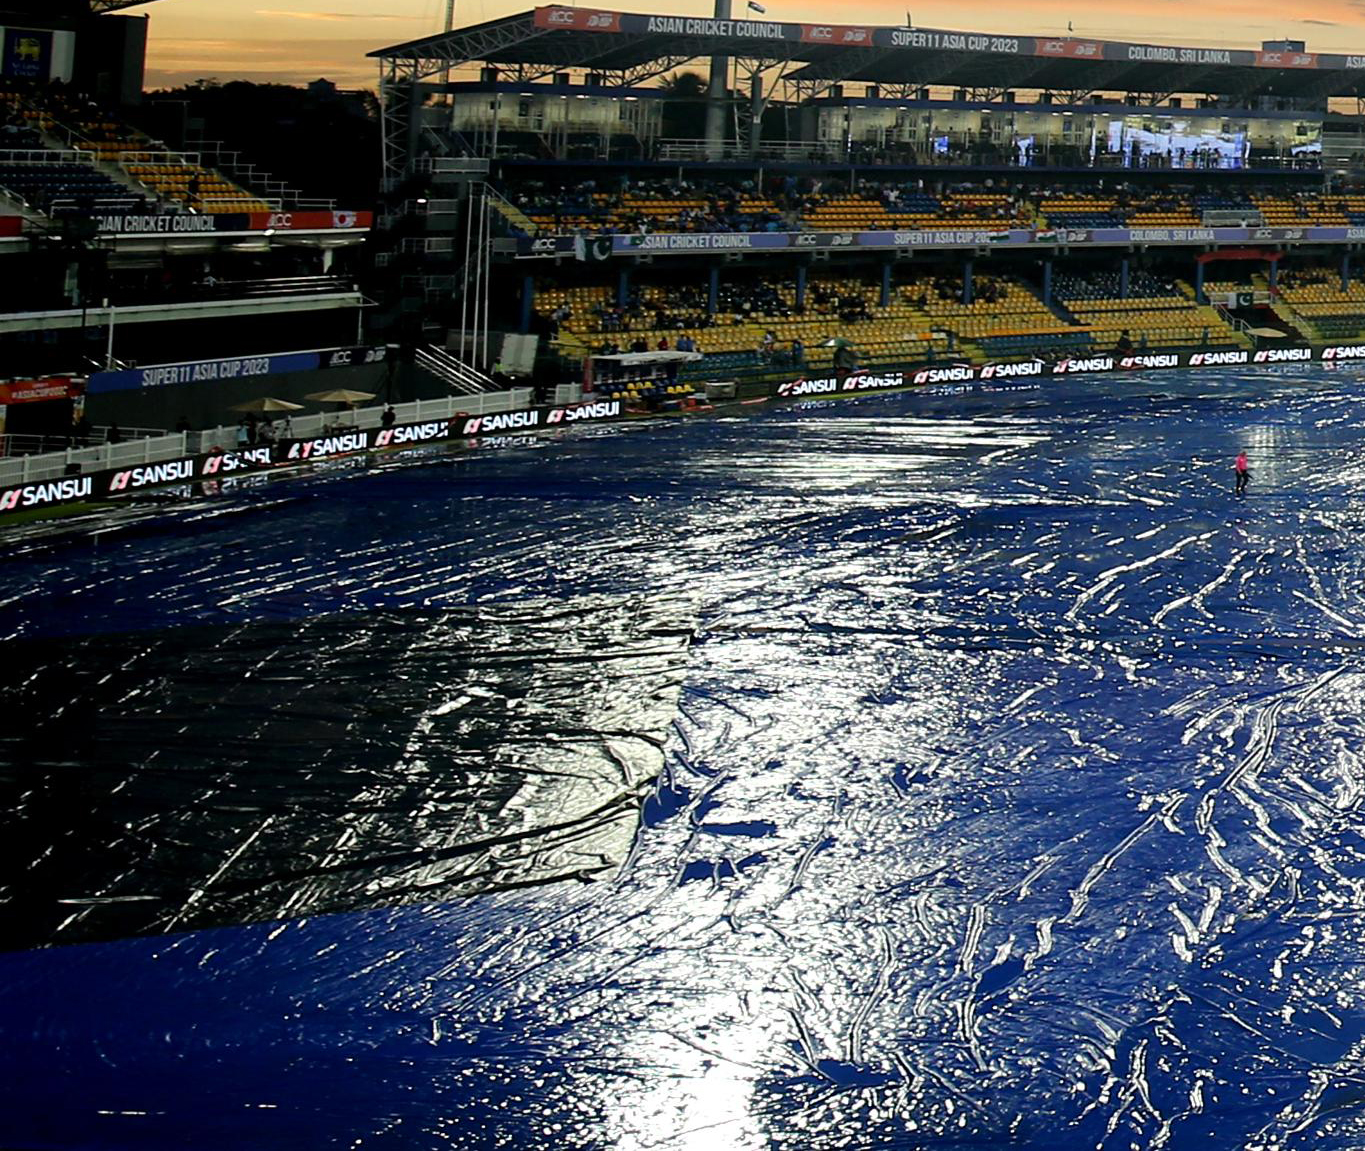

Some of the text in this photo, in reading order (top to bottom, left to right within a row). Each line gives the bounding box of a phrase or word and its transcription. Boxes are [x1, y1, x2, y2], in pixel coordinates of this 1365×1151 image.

[648, 16, 785, 39] ASIAN CRICKET COUNCIL
[942, 35, 966, 50] ASIA
[968, 37, 989, 51] CUP
[991, 37, 1018, 53] 2023
[1180, 49, 1197, 62] SRI
[1198, 50, 1231, 64] LANKA
[124, 215, 172, 231] CRICKET
[173, 215, 216, 230] COUNCIL
[670, 236, 711, 248] CRICKET
[713, 235, 752, 247] COUNCIL
[934, 232, 954, 244] ASIA
[955, 233, 974, 244] CUP
[1172, 230, 1186, 241] SRI
[1187, 229, 1214, 241] LANKA
[1204, 351, 1247, 365] SANSUI
[1267, 349, 1311, 362] SANSUI
[192, 362, 218, 381] ASIA
[219, 360, 242, 379] CUP
[243, 357, 269, 376] 2023
[995, 362, 1042, 377] SANSUI
[1067, 358, 1113, 372] SANSUI
[929, 368, 974, 383] SANSUI
[482, 411, 538, 433] SANSUI
[313, 433, 367, 456] SANSUI
[131, 460, 193, 486] SANSUI
[22, 478, 92, 506] SANSUI
